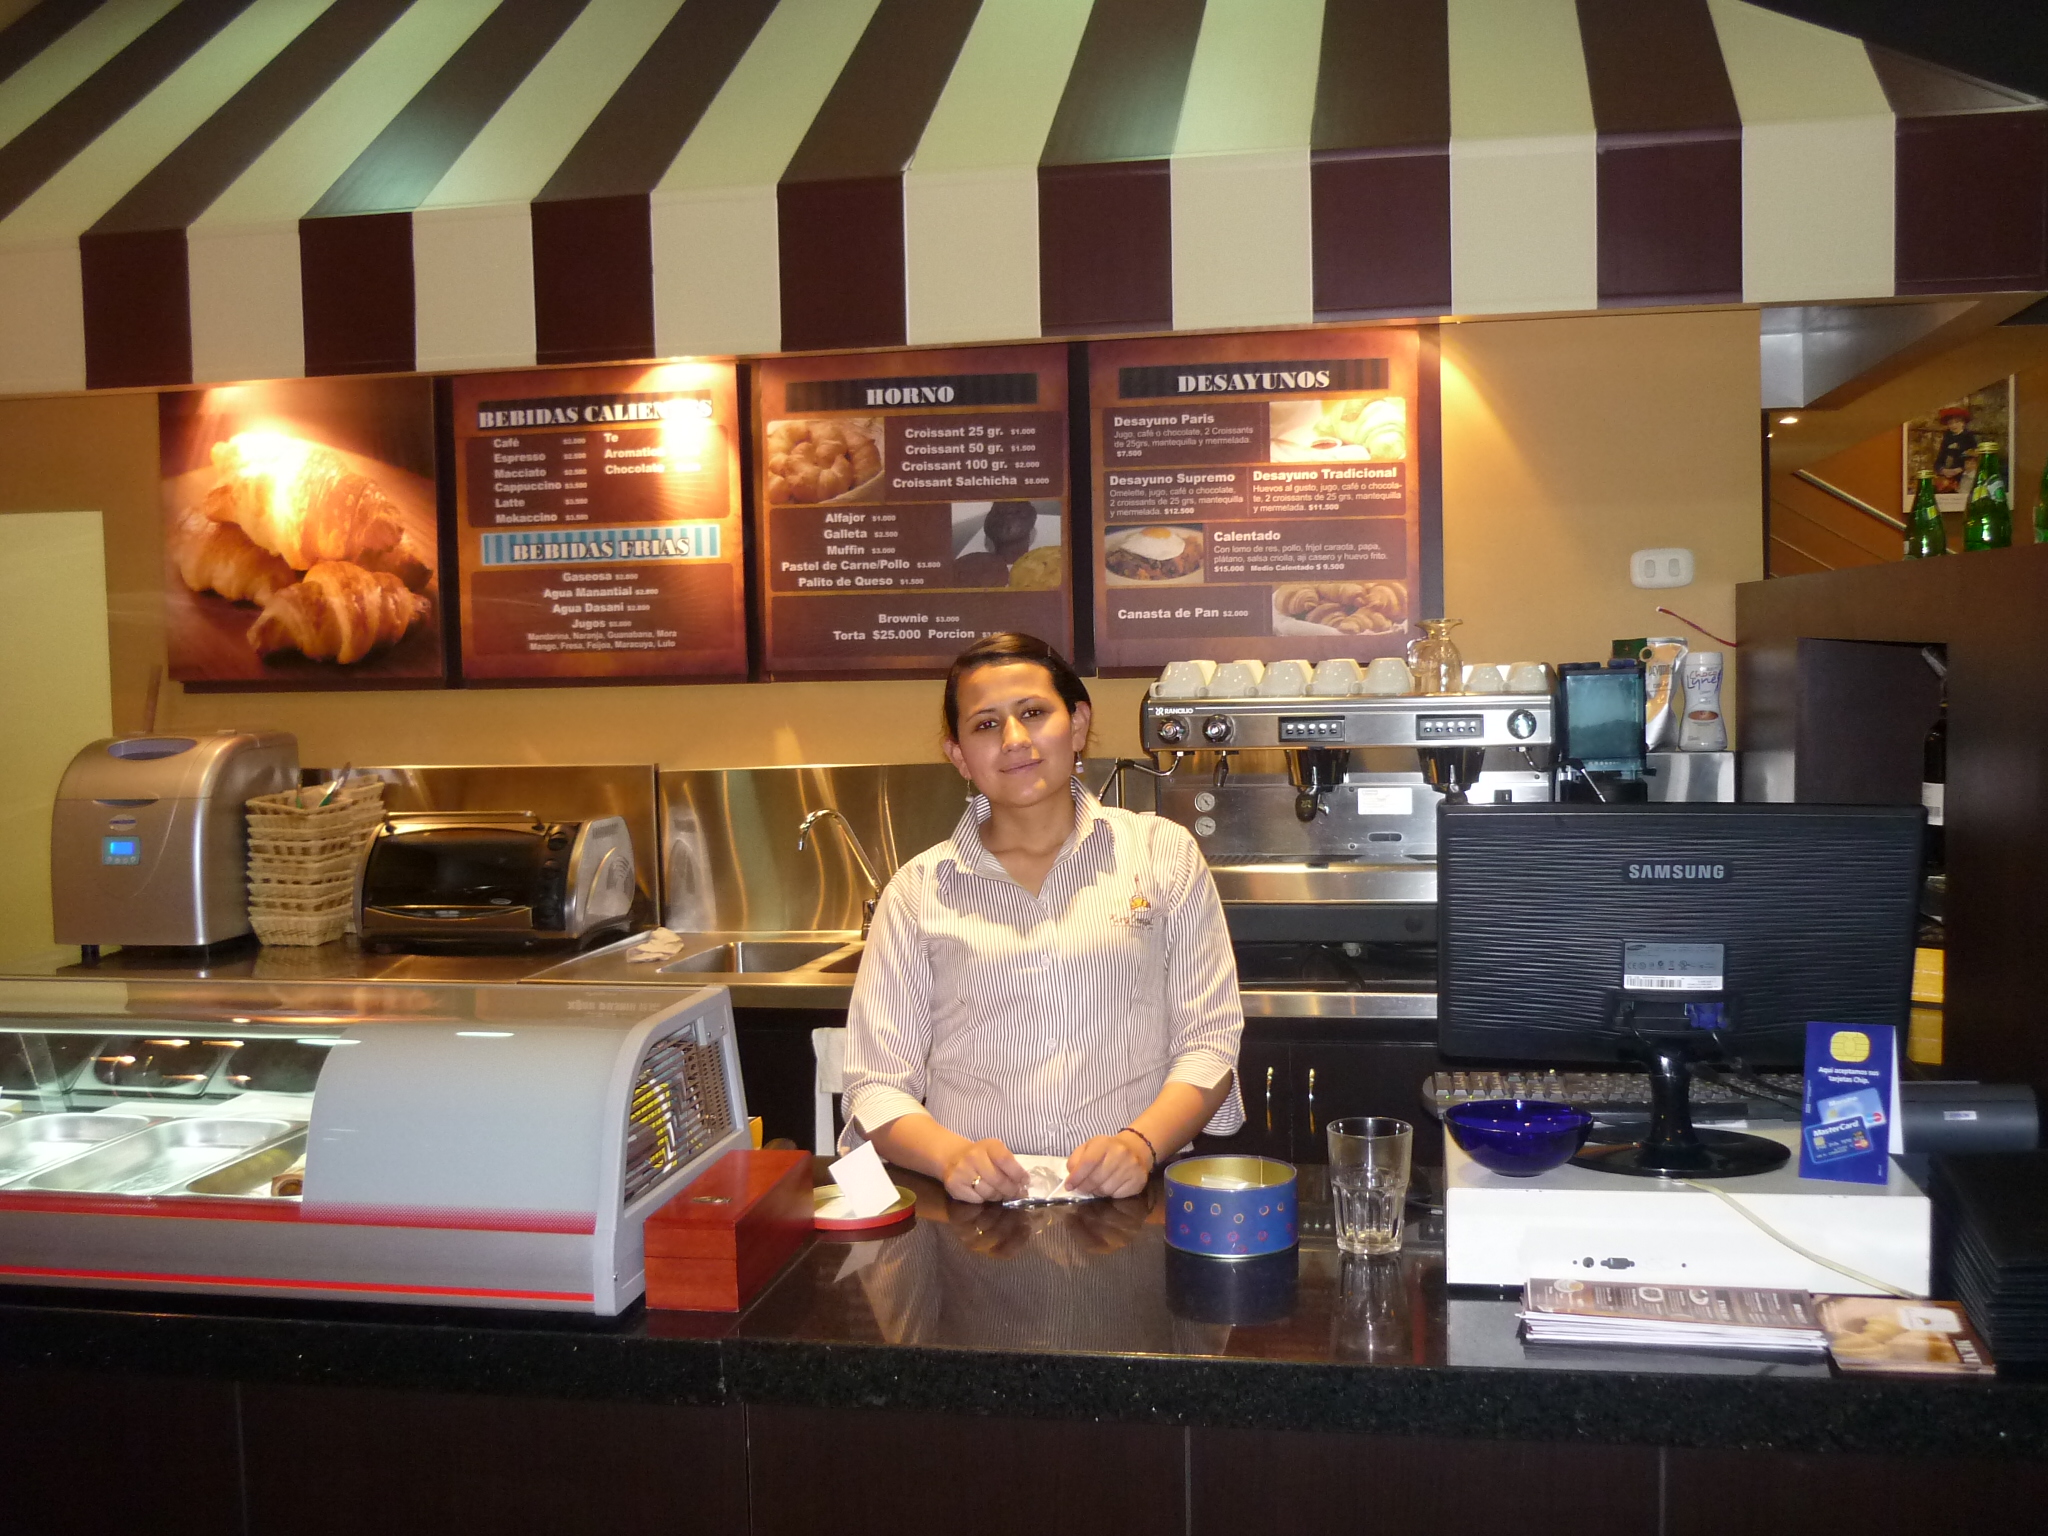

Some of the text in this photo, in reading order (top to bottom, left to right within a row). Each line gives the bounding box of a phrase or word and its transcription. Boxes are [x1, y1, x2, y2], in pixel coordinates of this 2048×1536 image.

[1177, 370, 1329, 393] DESAYUNOS
[866, 386, 954, 404] HORNO
[479, 407, 578, 428] BEBIDAS
[1114, 414, 1214, 428] Desayuno Paris
[604, 433, 618, 442] Te
[905, 428, 965, 438] Croissant
[969, 427, 984, 436] 25
[988, 427, 1003, 438] gr.
[494, 438, 520, 448] Café
[1152, 438, 1196, 447] mantequilla
[906, 444, 965, 454] Croissant
[969, 444, 984, 452] 50
[988, 444, 1003, 454] gr.
[494, 453, 546, 464] Espresso
[902, 461, 961, 471] Croissant
[966, 460, 988, 469] 100
[992, 460, 1007, 471] gr.
[494, 469, 546, 478] Macciato
[1253, 468, 1396, 482] Desayuno Tradicional
[893, 477, 952, 488] Croissant
[956, 476, 1017, 486] Salchicha
[1110, 474, 1235, 486] Desayuno Supremo
[495, 481, 562, 492] Cappuccino
[1199, 495, 1243, 504] mantequilla
[1273, 493, 1312, 501] croissants
[1356, 491, 1401, 500] mantequilla
[495, 499, 525, 508] Latte
[496, 513, 557, 523] Mokaccino
[826, 514, 866, 524] Alfajor
[824, 530, 867, 539] Galleta
[1214, 531, 1280, 542] Calentado
[513, 538, 689, 560] BEBIDAS FRIAS
[827, 546, 864, 555] Muffin
[782, 562, 819, 571] Pastel
[823, 562, 837, 570] de
[841, 560, 910, 570] Carne/Pollo
[562, 572, 612, 581] Gaseosa
[799, 578, 833, 587] Palito
[837, 577, 851, 586] de
[855, 577, 893, 586] Queso
[543, 587, 632, 599] Agua Manantial
[552, 602, 624, 615] Agua Dasani
[1118, 609, 1171, 619] Canasta
[1175, 608, 1191, 618] de
[1195, 608, 1219, 617] Pan
[878, 614, 928, 623] Brownie
[572, 619, 605, 630] Jugos
[833, 631, 866, 640] Torta
[873, 630, 921, 640] $25.000
[928, 629, 974, 639] Porcion
[1629, 864, 1724, 879] SAMSUNG
[1813, 1120, 1859, 1137] MasterCard
